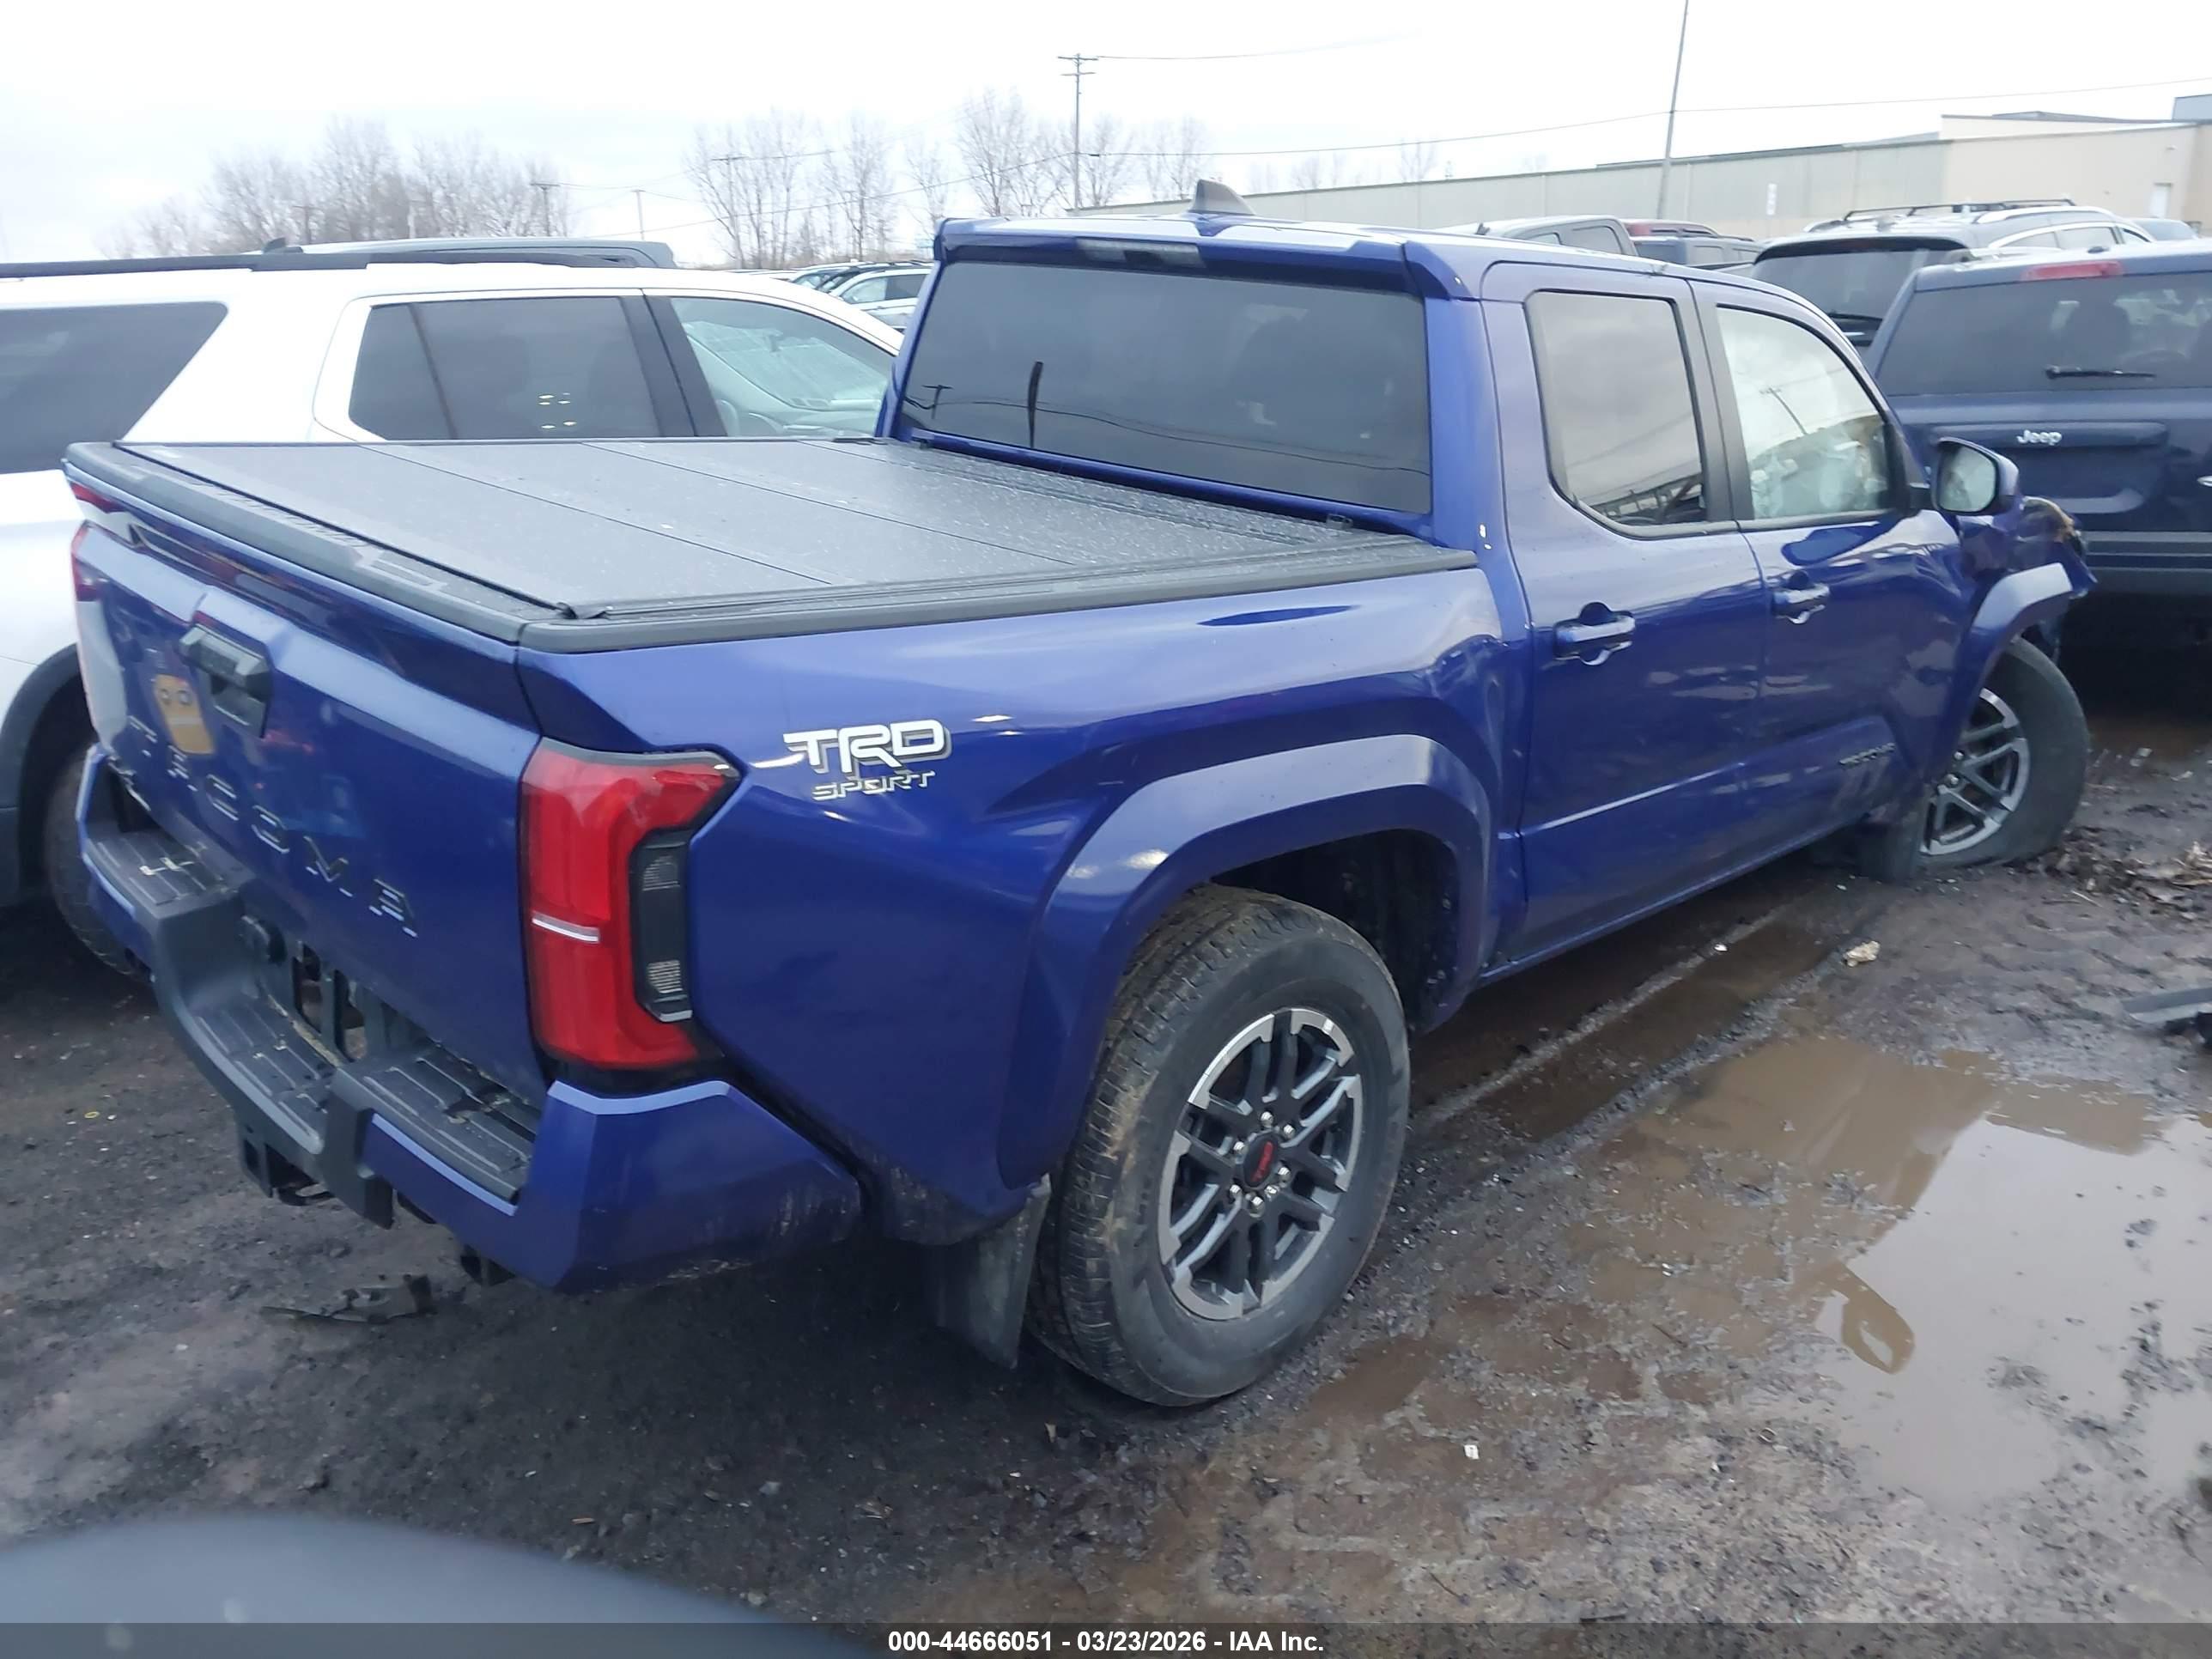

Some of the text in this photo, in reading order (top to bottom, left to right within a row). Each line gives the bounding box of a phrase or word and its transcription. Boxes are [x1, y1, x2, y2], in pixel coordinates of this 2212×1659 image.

[2016, 429, 2062, 446] Jeep
[782, 719, 952, 780] TRD
[811, 770, 936, 801] SPORT
